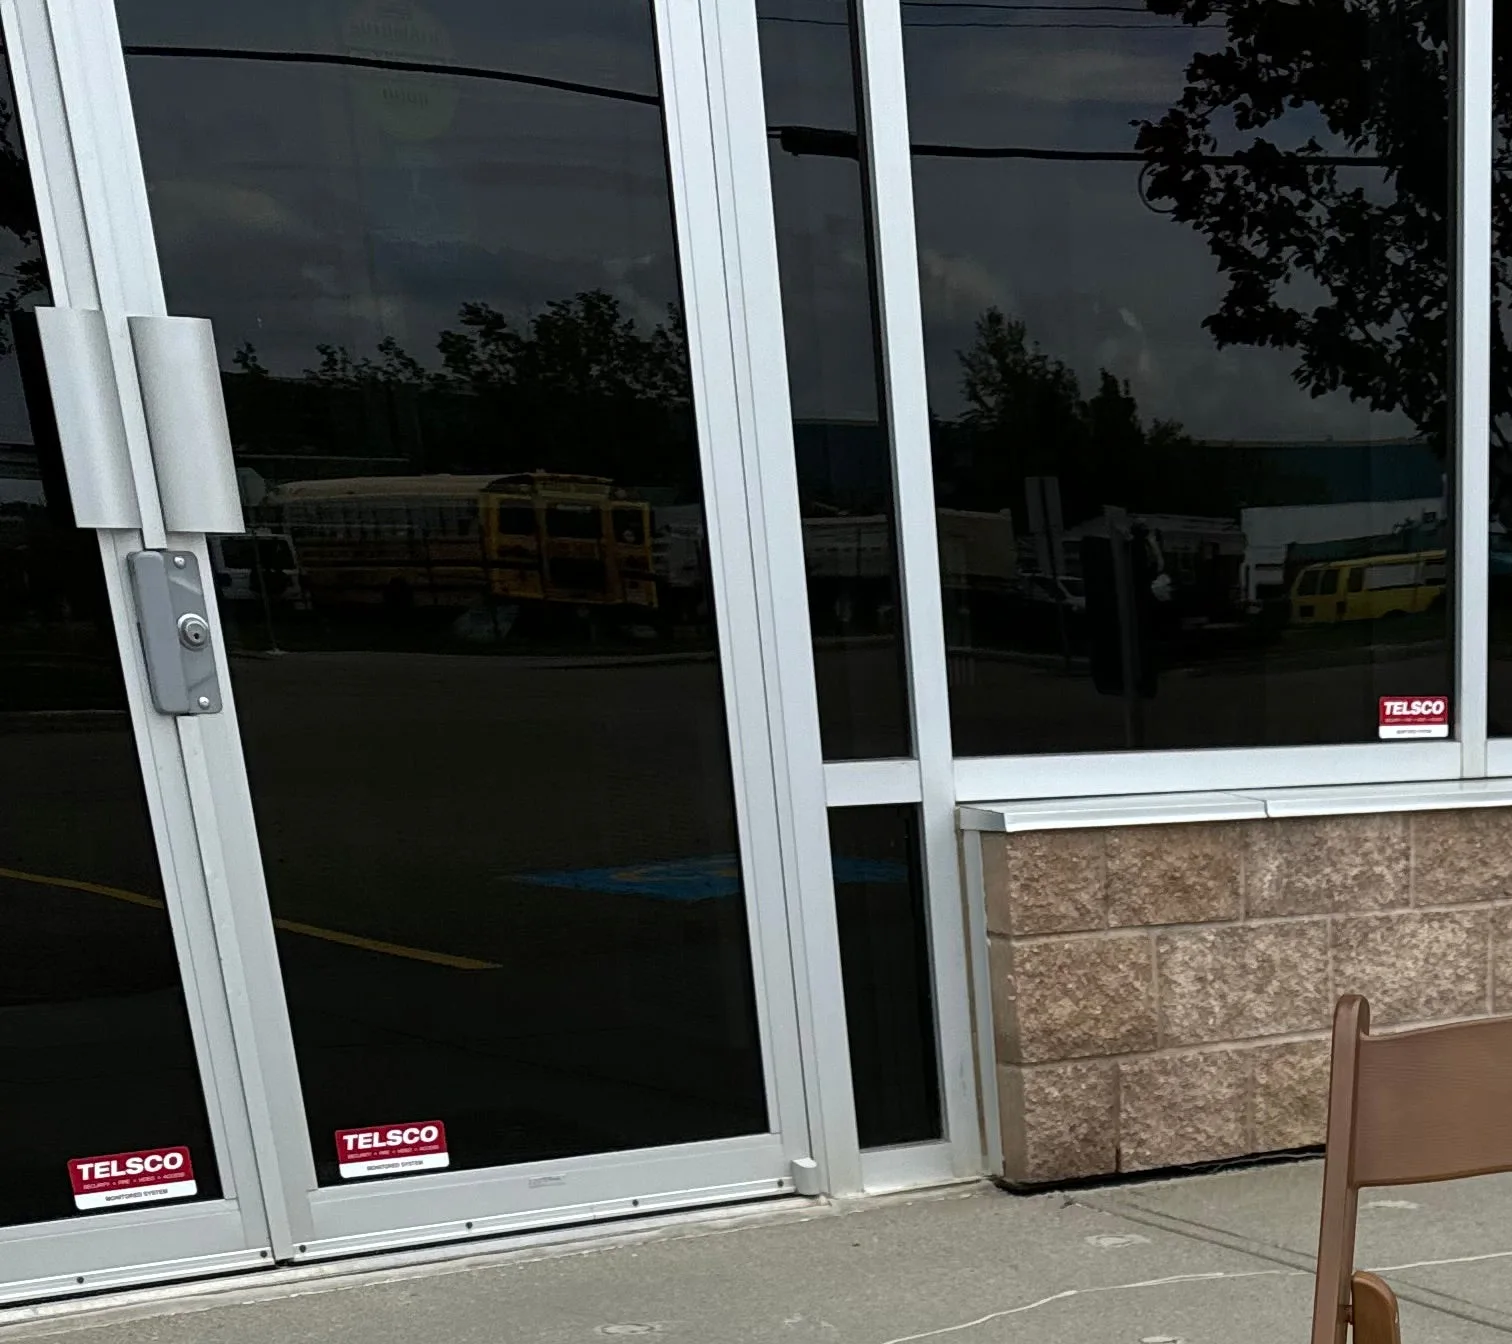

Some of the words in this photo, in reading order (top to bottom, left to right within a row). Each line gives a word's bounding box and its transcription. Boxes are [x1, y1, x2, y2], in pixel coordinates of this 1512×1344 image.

[1384, 700, 1445, 715] TELSCO
[343, 1125, 439, 1151] TELSCO
[76, 1152, 184, 1181] TELSCO
